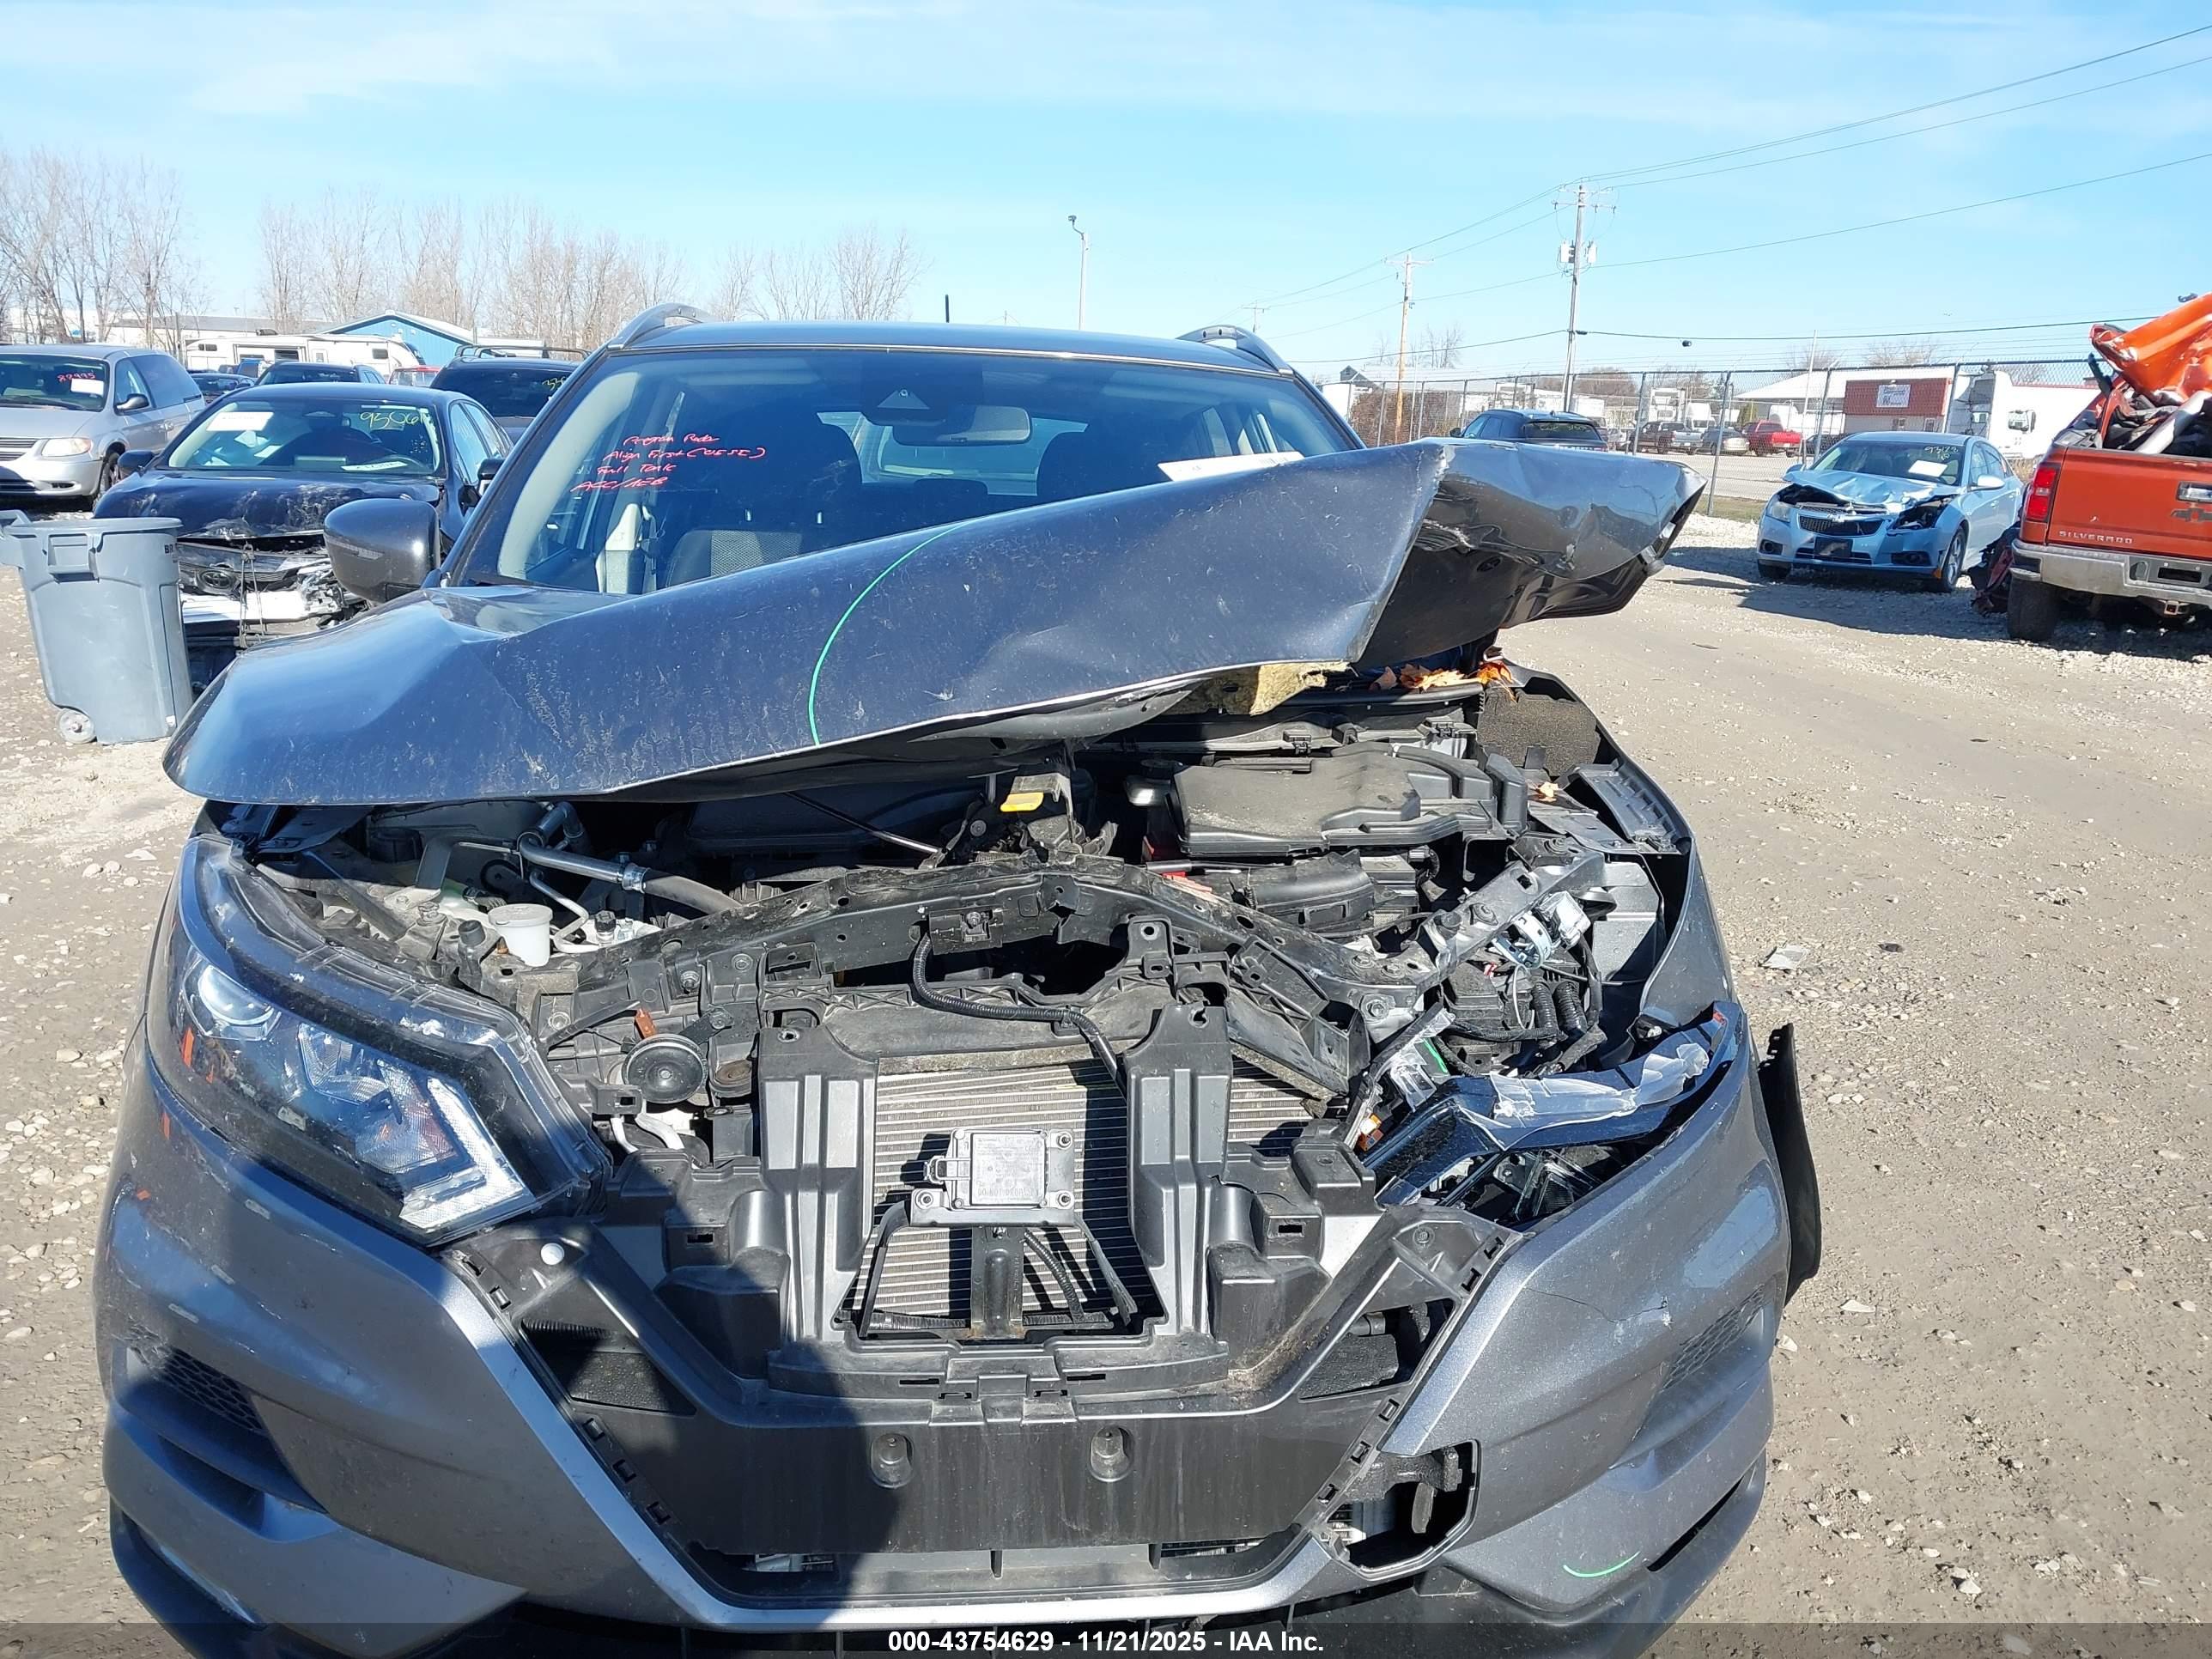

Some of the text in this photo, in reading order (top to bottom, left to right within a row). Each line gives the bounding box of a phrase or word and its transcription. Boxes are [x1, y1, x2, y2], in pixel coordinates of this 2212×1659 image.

[603, 448, 641, 462] Align
[597, 465, 628, 476] Full
[2058, 530, 2134, 544] SILVERADO
